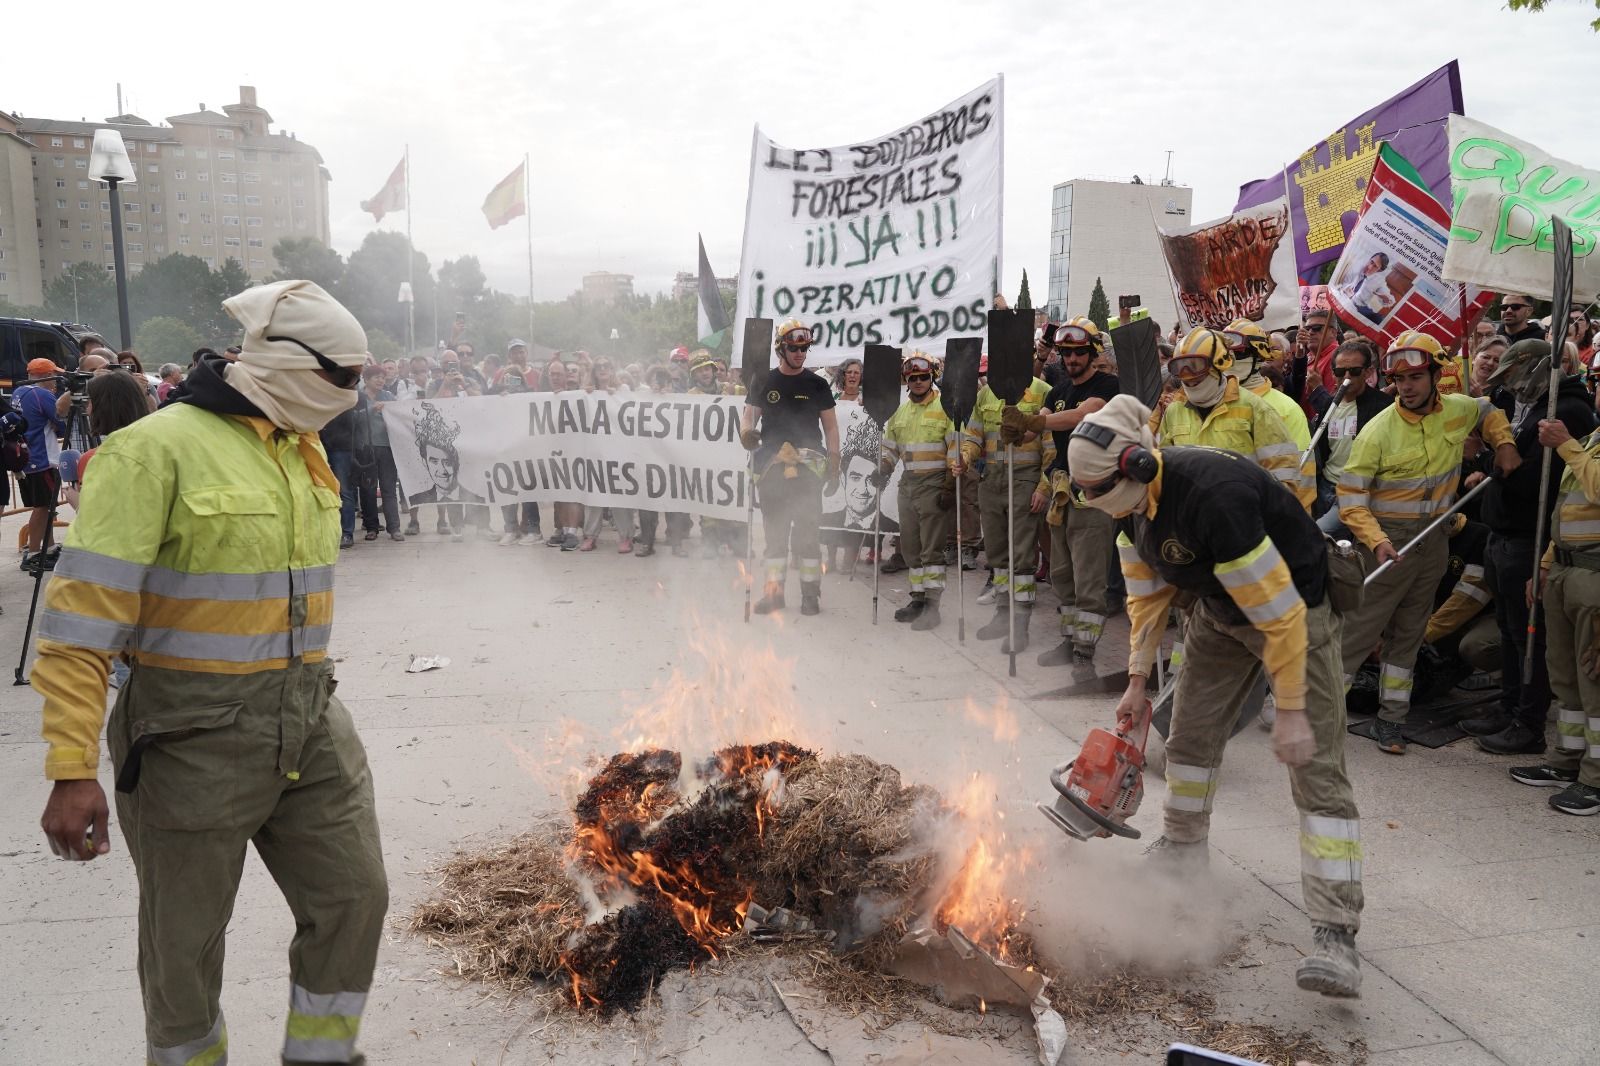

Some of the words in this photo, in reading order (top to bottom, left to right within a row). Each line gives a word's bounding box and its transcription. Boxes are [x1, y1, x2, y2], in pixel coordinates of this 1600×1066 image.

[792, 154, 962, 218] FORESTALES
[1207, 217, 1279, 258] ARDE
[1364, 225, 1375, 235] todo
[1379, 236, 1390, 246] año
[1395, 248, 1417, 264] absurdo
[1384, 220, 1397, 231] Juan
[1396, 228, 1413, 241] Carlos
[1403, 243, 1428, 261] operativo
[1181, 283, 1243, 312] ESPAÑA
[1246, 278, 1268, 298] POR
[813, 317, 882, 348] OMOS
[889, 298, 988, 344] TODOS
[528, 400, 611, 438] MALA
[484, 450, 639, 503] ¡QUIÑONES
[646, 463, 746, 509] DIMISI
